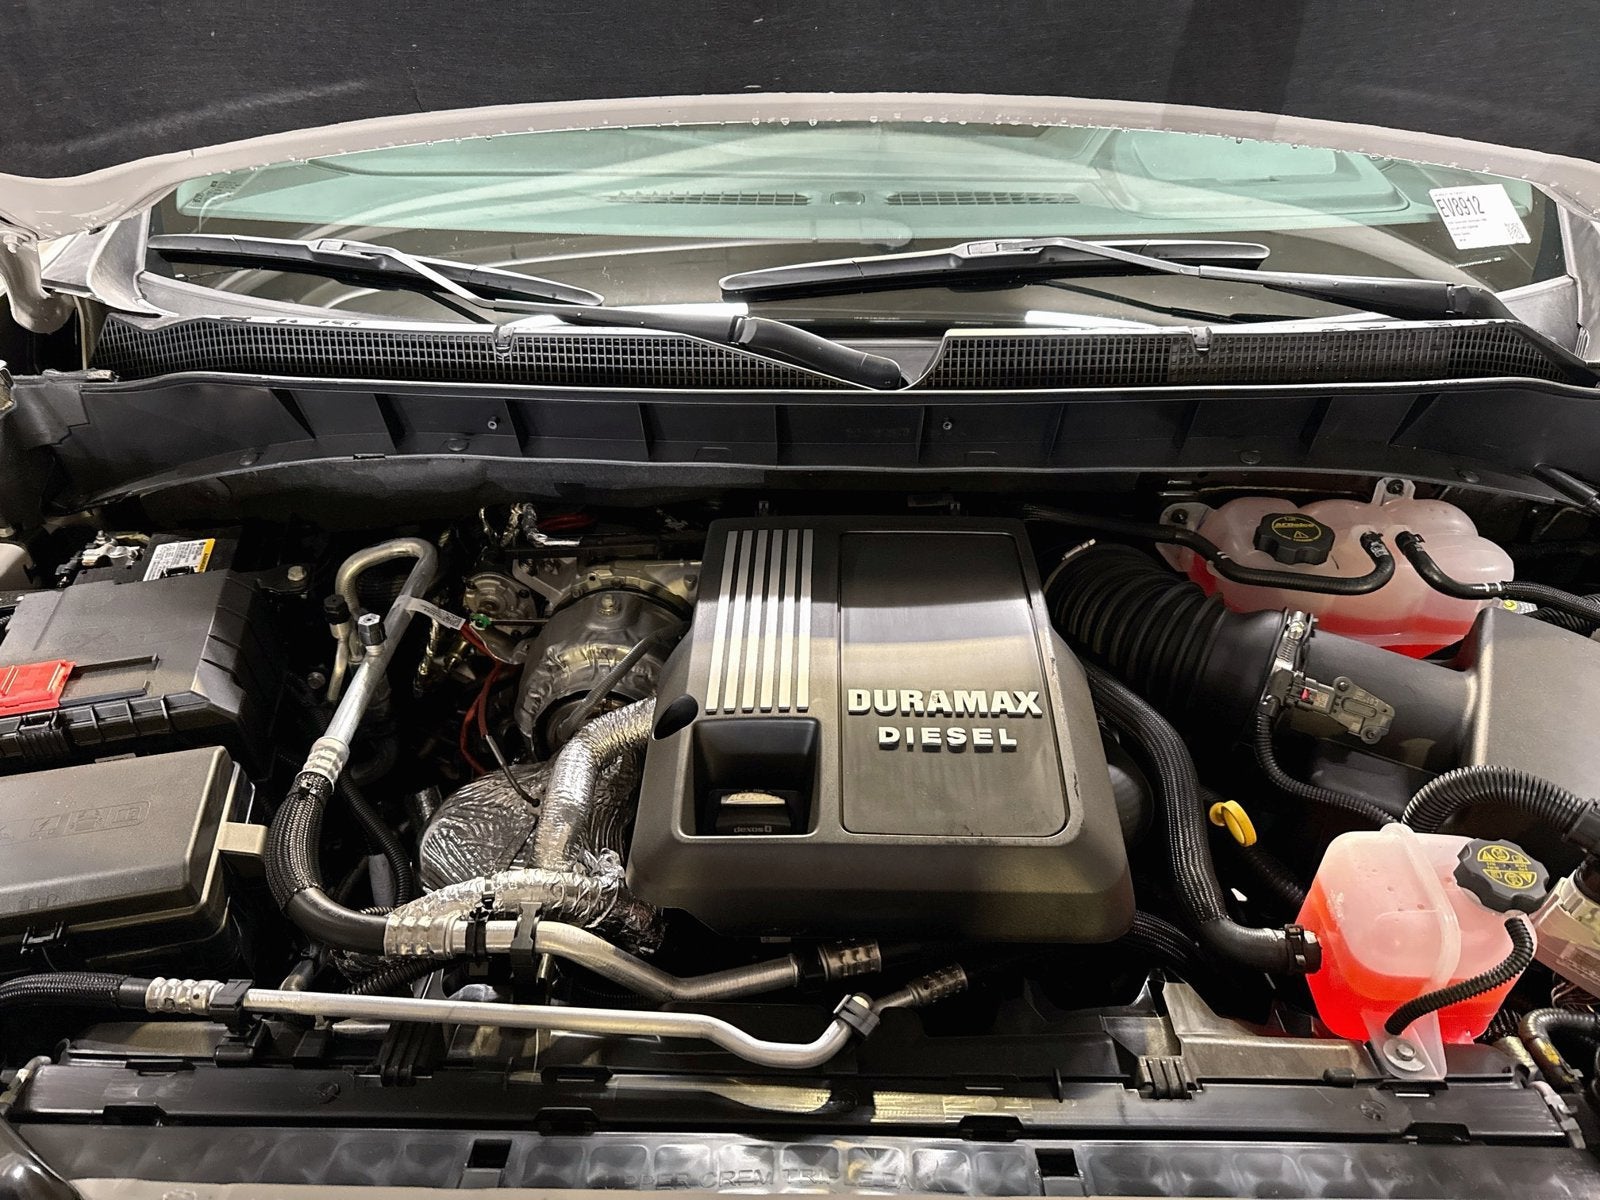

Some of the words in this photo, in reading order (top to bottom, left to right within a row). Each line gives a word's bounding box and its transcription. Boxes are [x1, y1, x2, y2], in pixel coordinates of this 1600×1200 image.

[1436, 195, 1485, 217] EV8912
[847, 688, 1043, 718] DURAMAX
[878, 726, 1018, 752] DIESEL
